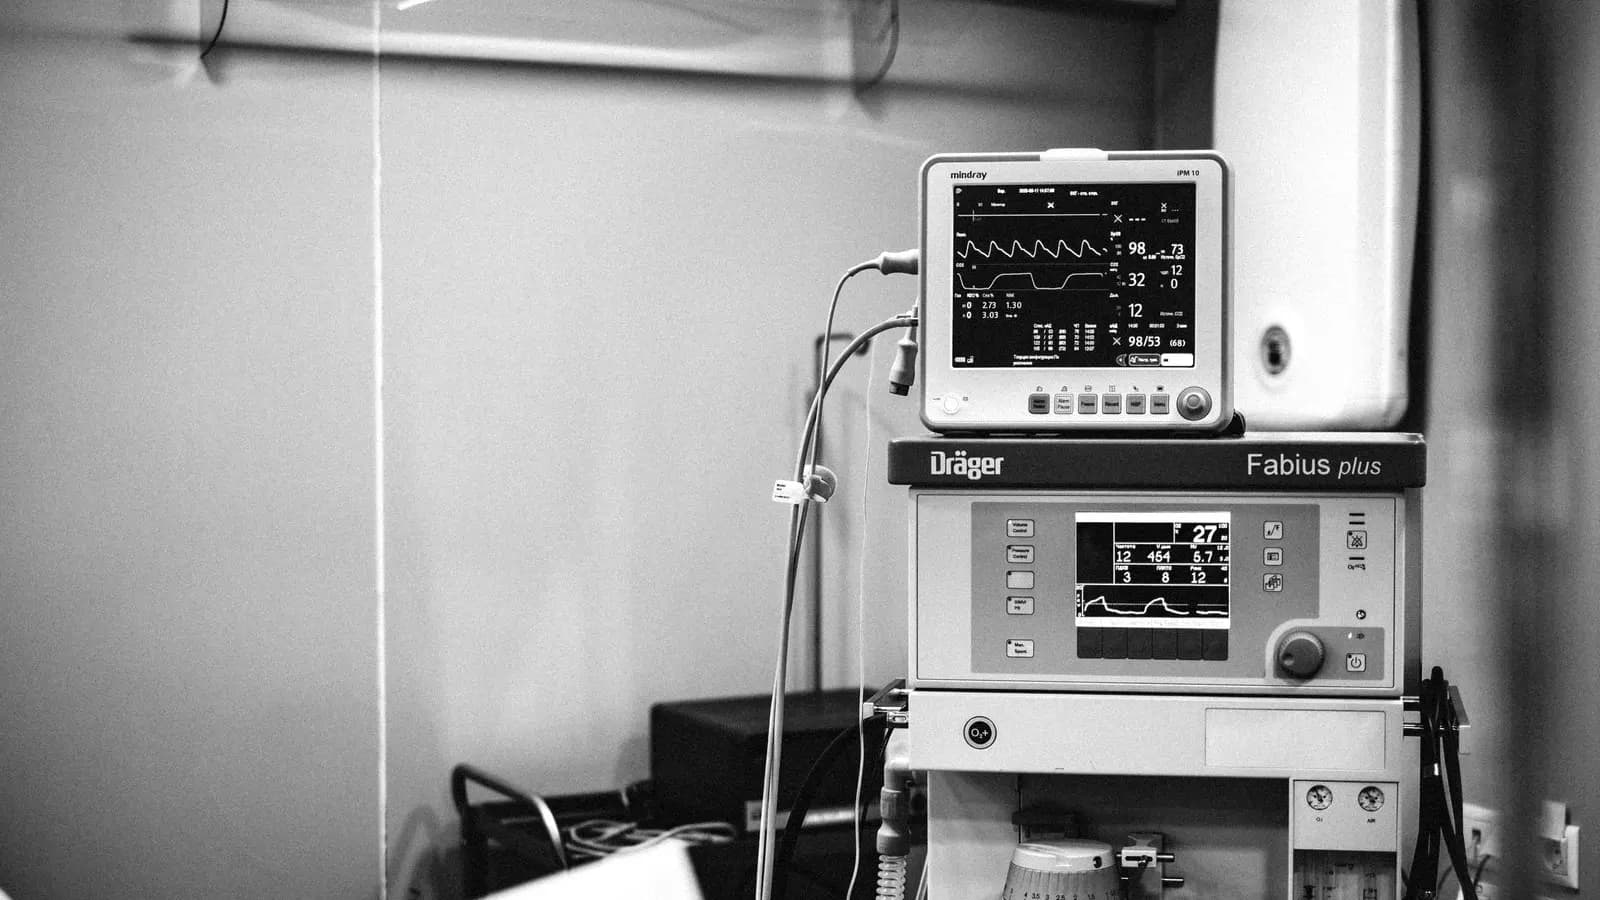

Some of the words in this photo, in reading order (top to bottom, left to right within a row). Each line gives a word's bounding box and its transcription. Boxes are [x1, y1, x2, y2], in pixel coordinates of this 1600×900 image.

[950, 170, 987, 180] mindray
[1191, 169, 1200, 177] 10
[1128, 241, 1146, 255] 98
[1171, 243, 1184, 255] 73
[1171, 264, 1183, 276] 12
[1128, 272, 1146, 287] 32
[1170, 278, 1178, 290] 0
[966, 301, 972, 309] 0
[982, 301, 997, 309] 2.73
[1006, 301, 1022, 309] 1.30
[1128, 303, 1143, 318] 12
[966, 311, 972, 319] 0
[982, 311, 999, 319] 3.03
[1128, 335, 1161, 347] 98/53
[1169, 339, 1186, 347] (68)
[930, 450, 1004, 480] Dräger
[1247, 453, 1331, 475] Fabius
[1338, 456, 1382, 479] plus
[1192, 525, 1217, 543] 27
[1116, 551, 1132, 562] 12
[1147, 551, 1171, 563] 454
[1193, 551, 1213, 563] 5.7
[1123, 572, 1132, 583] 3
[1161, 572, 1170, 583] 8
[1191, 572, 1206, 584] 12
